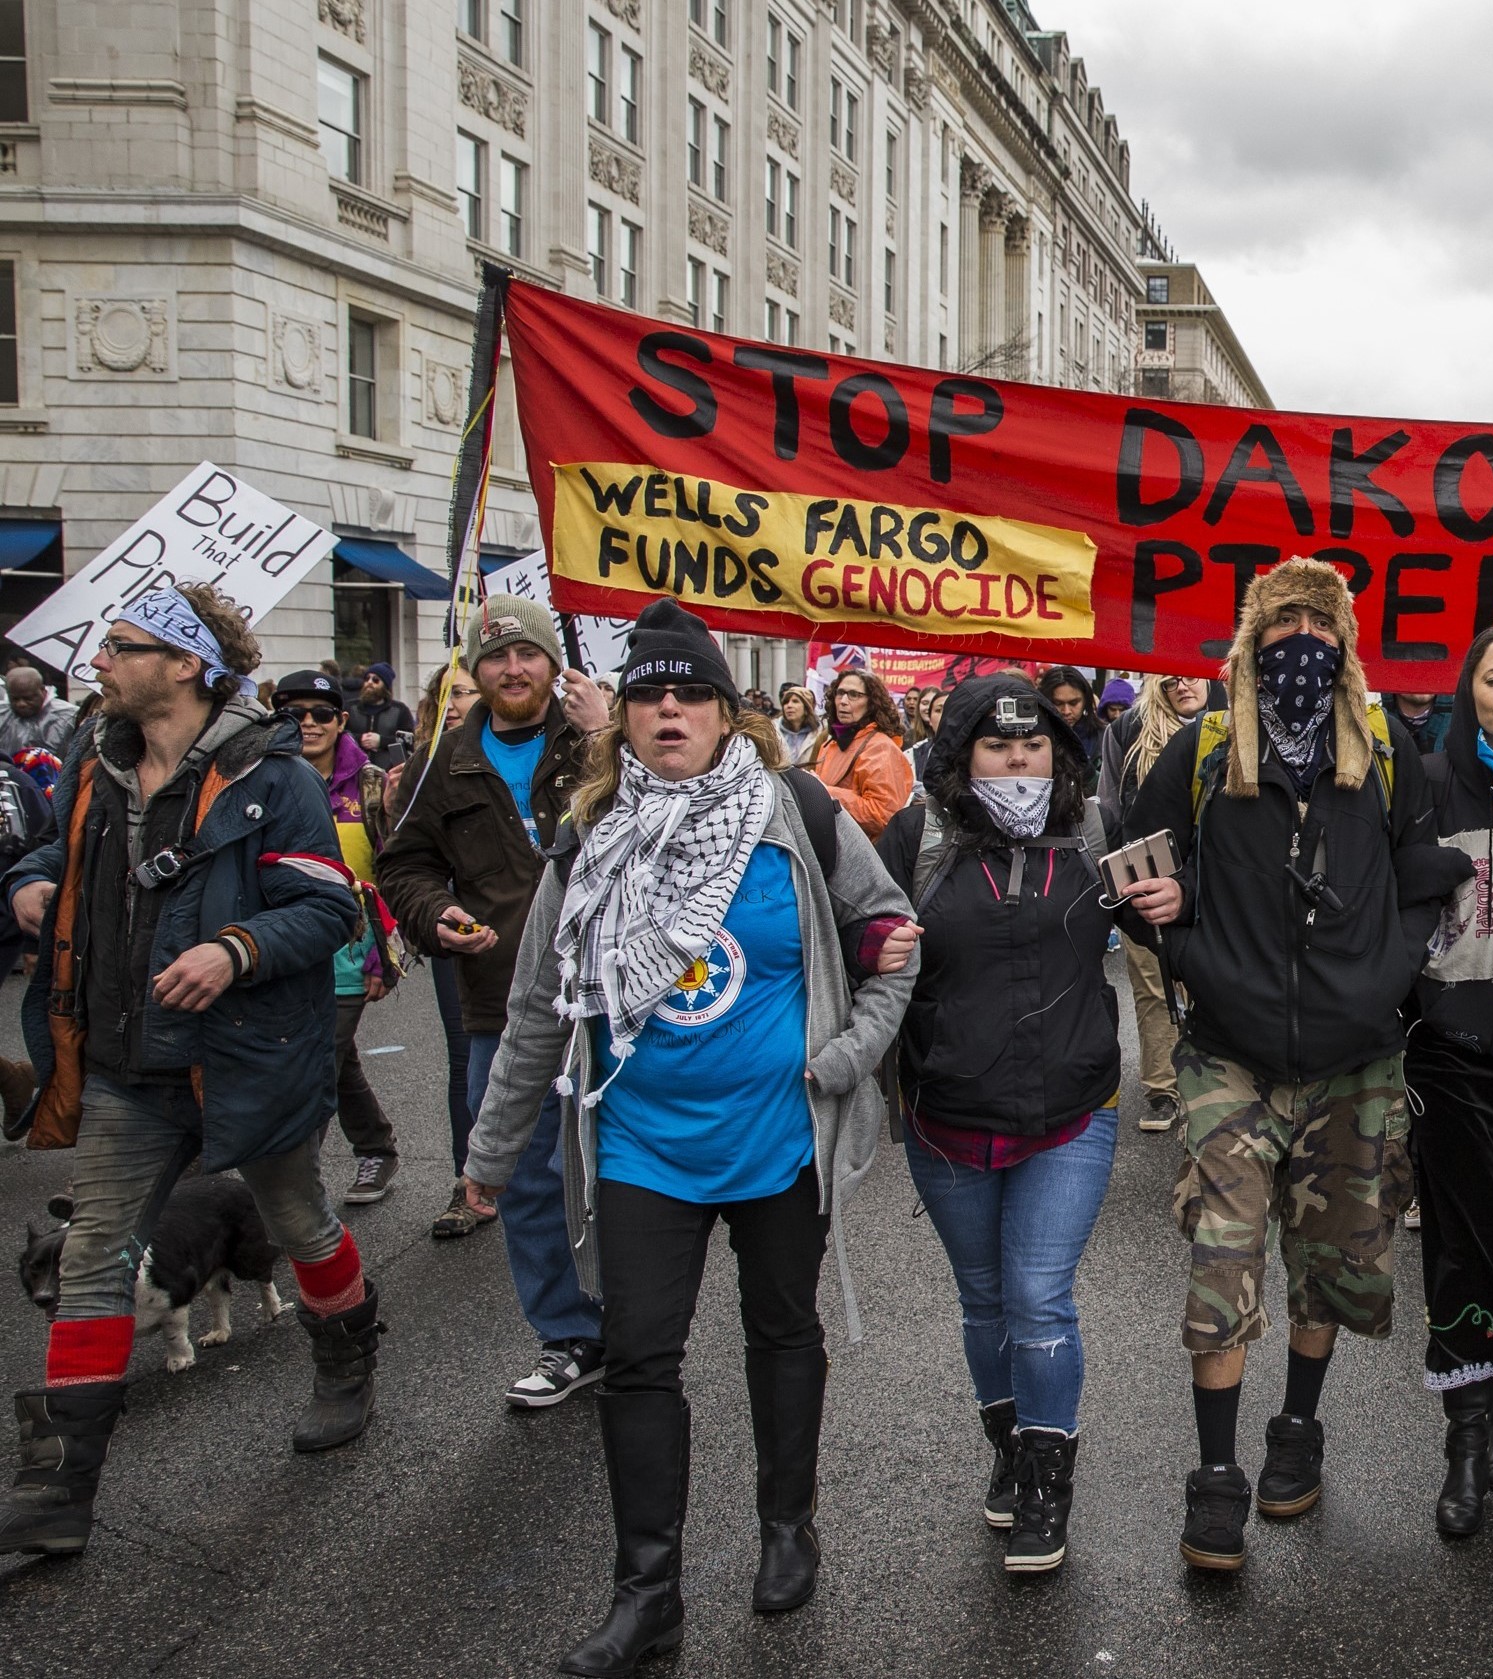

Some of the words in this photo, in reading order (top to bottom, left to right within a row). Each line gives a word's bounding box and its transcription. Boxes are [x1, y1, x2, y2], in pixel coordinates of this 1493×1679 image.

[628, 331, 1005, 484] STOP
[176, 471, 323, 577] Build
[579, 467, 769, 537] WELLS
[805, 499, 989, 571] FARGO
[192, 535, 242, 570] That
[599, 526, 782, 603] FUNDS
[801, 559, 1064, 620] GENOCIDE
[626, 662, 653, 685] WATER
[655, 660, 666, 673] IS
[669, 660, 693, 675] LIFE
[879, 660, 891, 670] OF
[892, 659, 946, 671] LIBERATION
[728, 941, 741, 960] TRIBE
